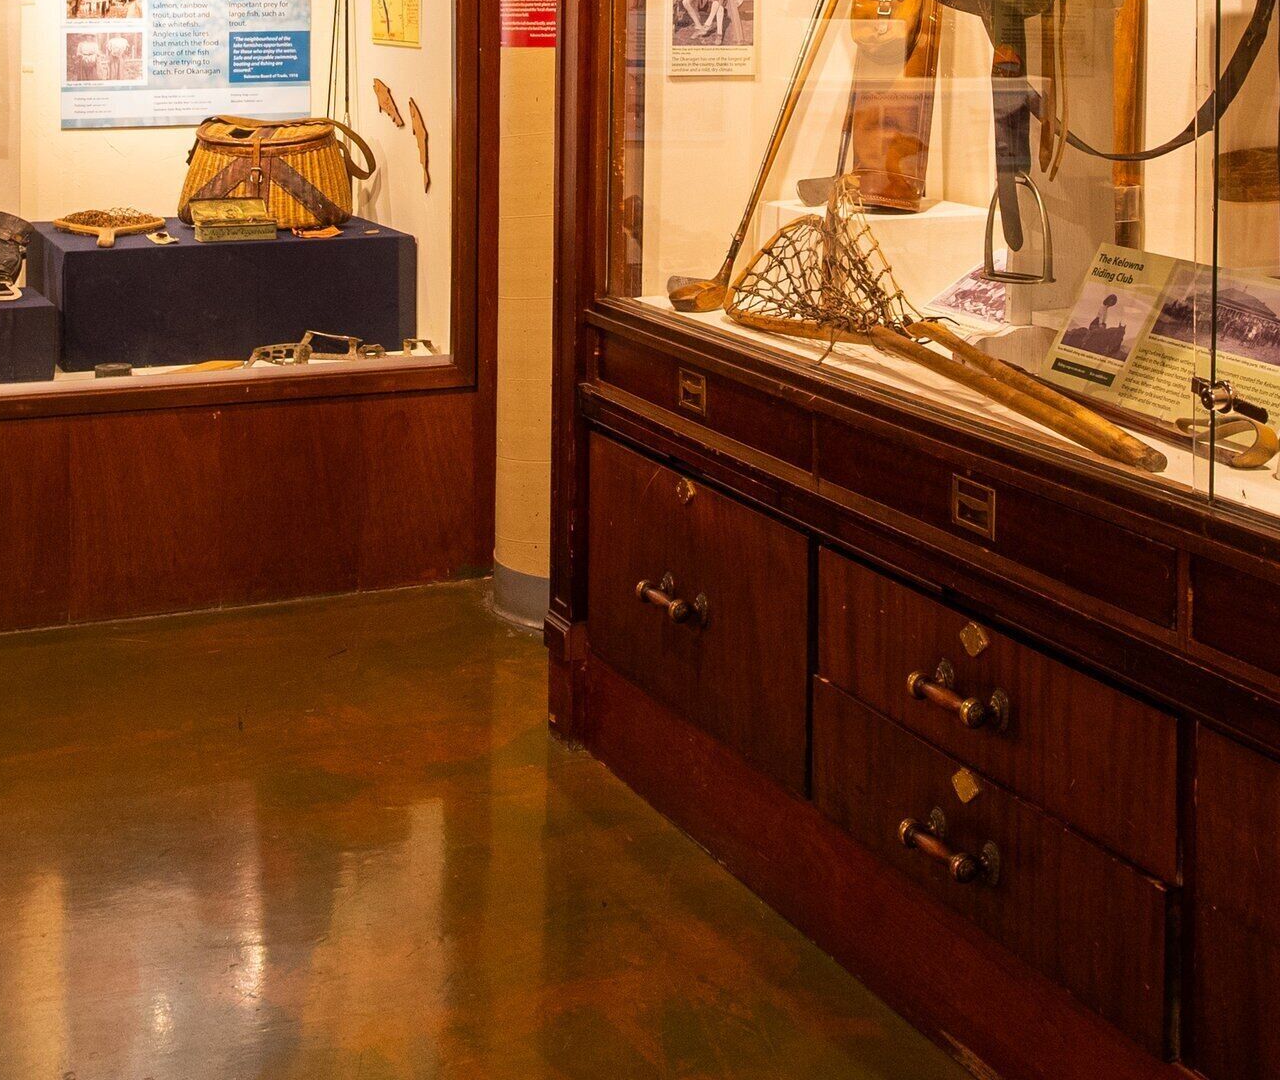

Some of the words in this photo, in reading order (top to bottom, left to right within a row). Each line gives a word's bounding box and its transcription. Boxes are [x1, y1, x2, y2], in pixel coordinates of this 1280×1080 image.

[1099, 253, 1112, 264] The
[1112, 257, 1145, 271] Kelowna
[1092, 267, 1116, 282] Riding
[1116, 272, 1134, 284] Club
